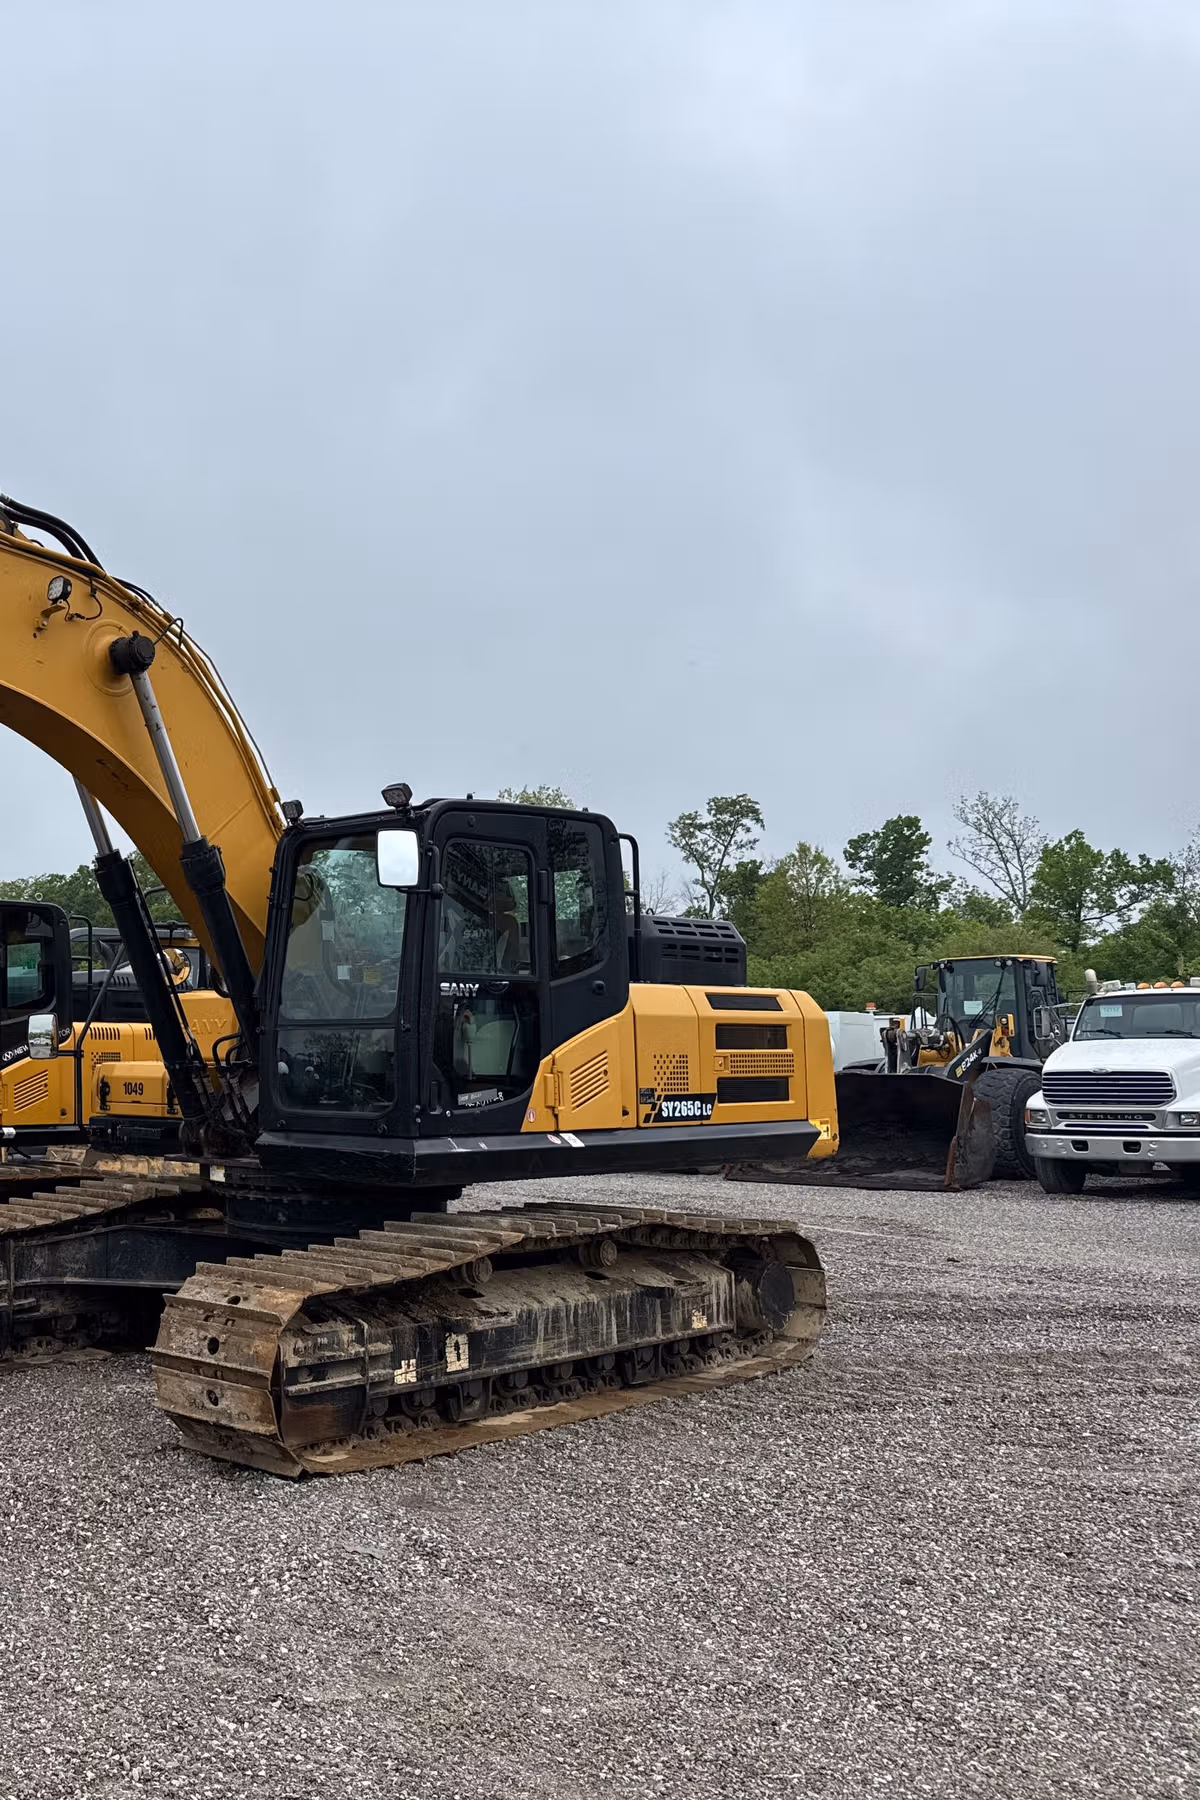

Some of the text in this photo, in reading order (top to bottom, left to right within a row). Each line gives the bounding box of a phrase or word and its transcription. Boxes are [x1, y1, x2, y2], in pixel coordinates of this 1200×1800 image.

[440, 982, 480, 998] SANY
[123, 1081, 144, 1096] 1049
[661, 1100, 712, 1118] SY265C LC
[1068, 1112, 1143, 1120] STERLING
